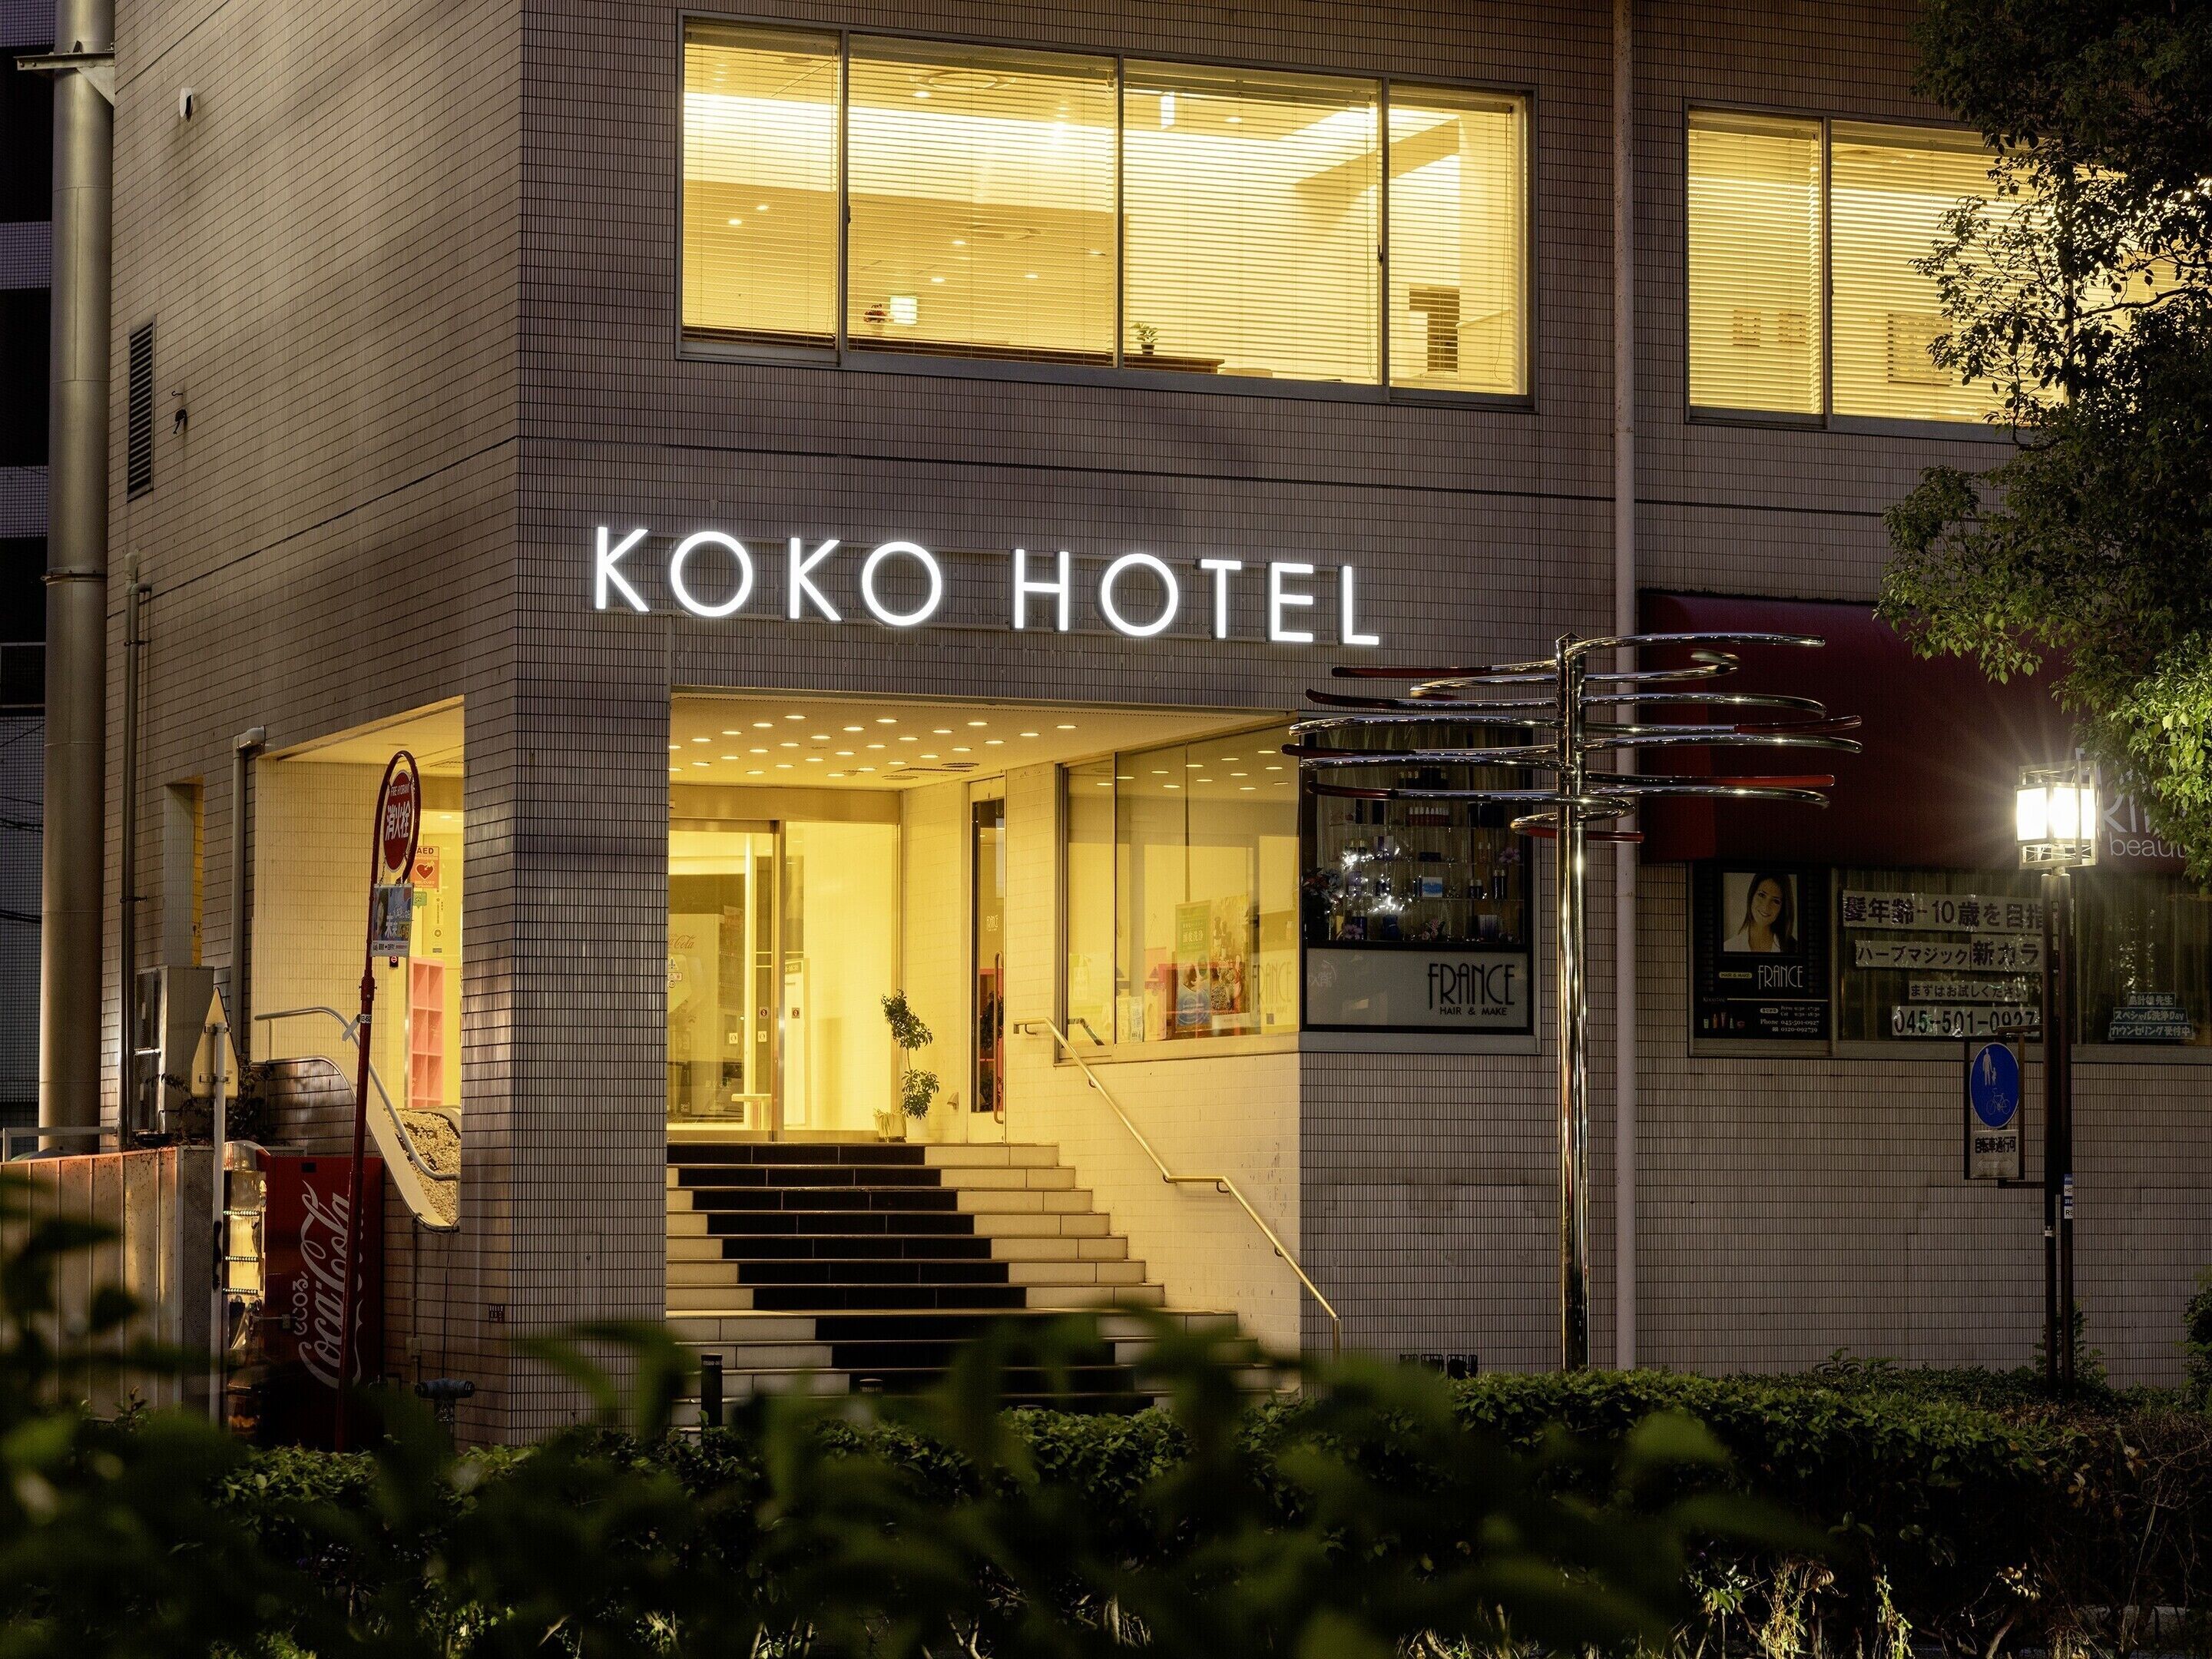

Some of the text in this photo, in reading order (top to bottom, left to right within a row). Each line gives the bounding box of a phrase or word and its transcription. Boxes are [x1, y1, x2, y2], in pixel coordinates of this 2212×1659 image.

[594, 525, 1379, 647] KOKO HOTEL
[385, 800, 411, 841] 消火栓
[1427, 962, 1515, 1010] FRANCE
[1758, 965, 1803, 990] FRANCE
[1910, 985, 2028, 998] まずはお試しください
[1439, 1007, 1508, 1016] HAIR & MAKE
[1893, 1008, 2035, 1034] 045-501-0927
[1975, 1137, 2016, 1154] 自転車通行可
[299, 1180, 363, 1389] Coca-Cola
